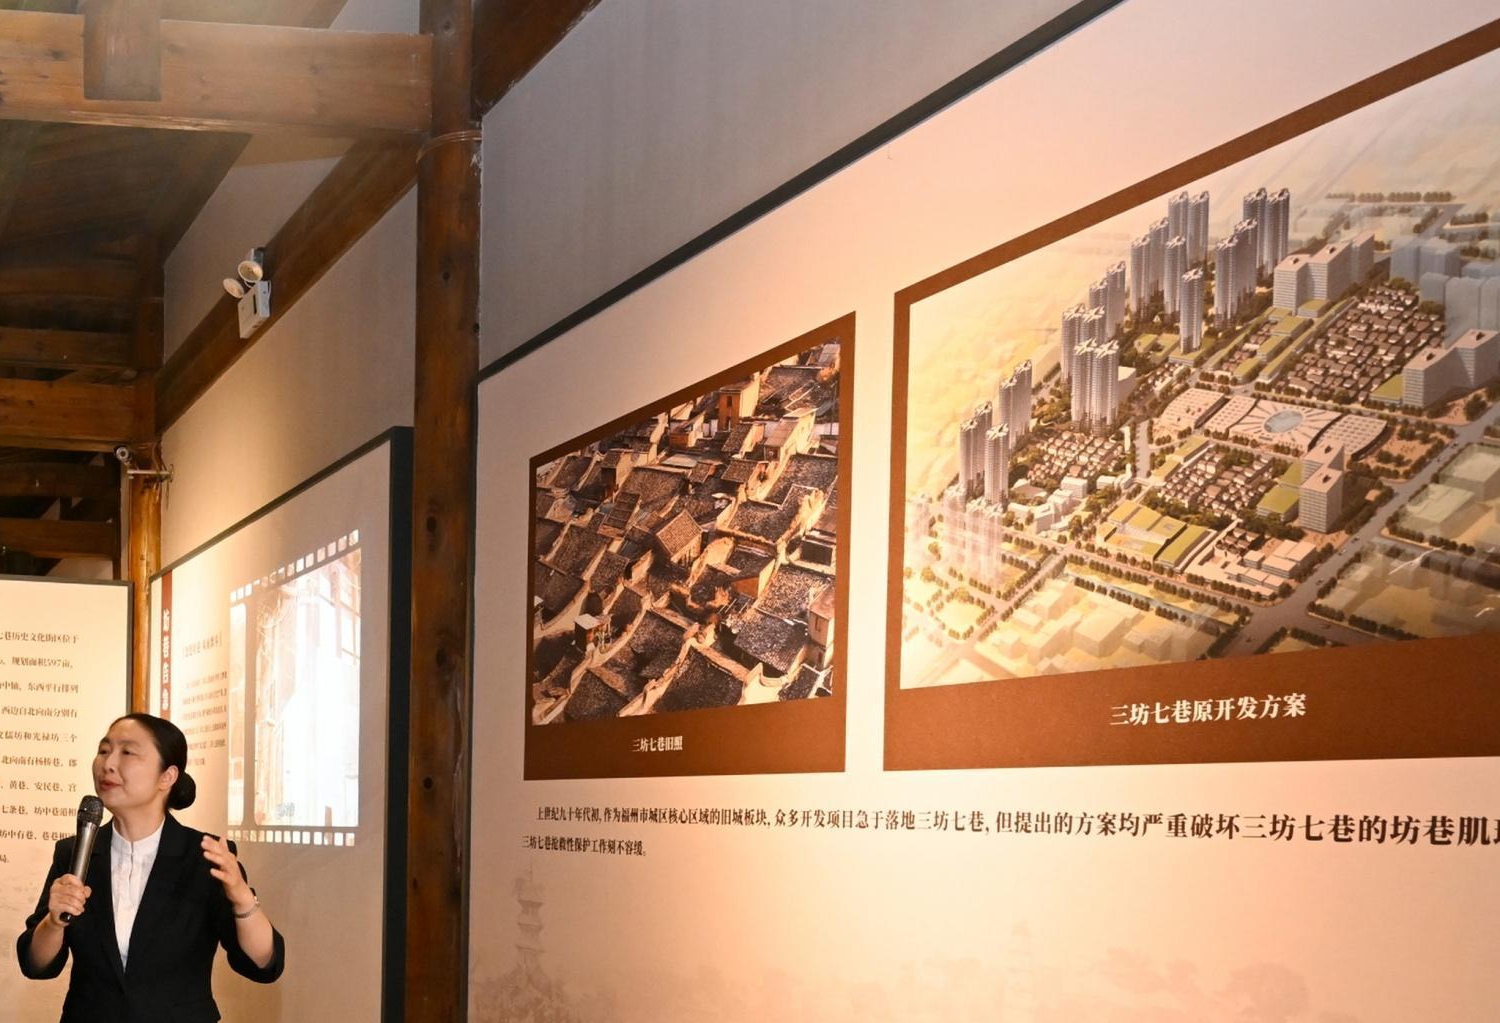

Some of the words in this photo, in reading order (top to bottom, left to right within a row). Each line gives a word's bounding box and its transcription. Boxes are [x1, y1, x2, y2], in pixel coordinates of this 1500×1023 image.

[1110, 693, 1307, 726] 三坊七巷原开发方案
[630, 735, 683, 753] 三坊七巷旧照
[523, 835, 647, 857] 三坊七巷抢救性保护工作刻不容缓。
